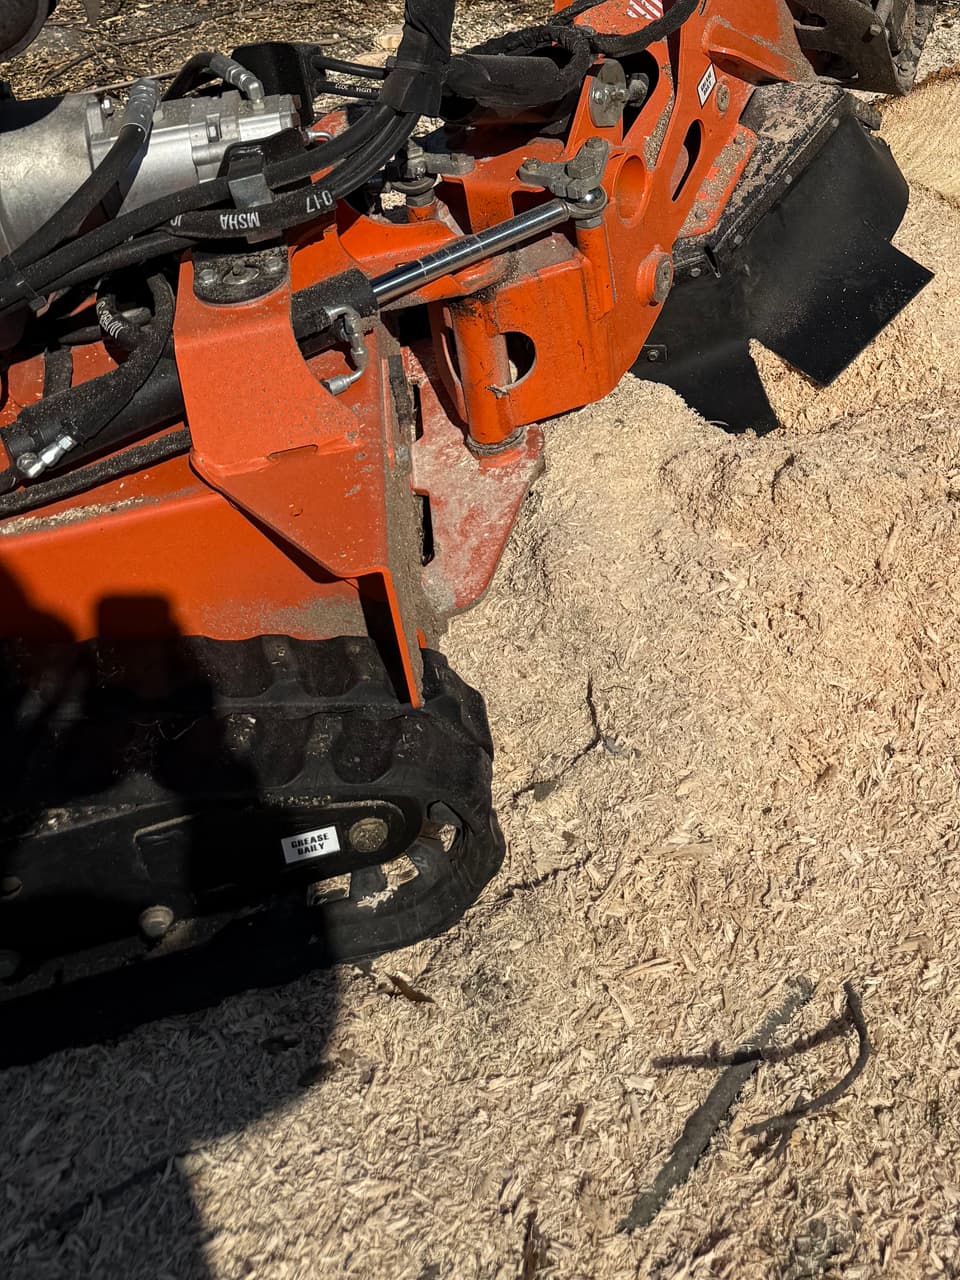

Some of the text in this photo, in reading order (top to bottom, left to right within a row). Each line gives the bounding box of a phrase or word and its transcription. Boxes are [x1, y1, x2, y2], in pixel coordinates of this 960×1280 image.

[219, 211, 261, 230] MSHA
[291, 832, 330, 849] GREASE
[297, 842, 325, 855] DAILY
